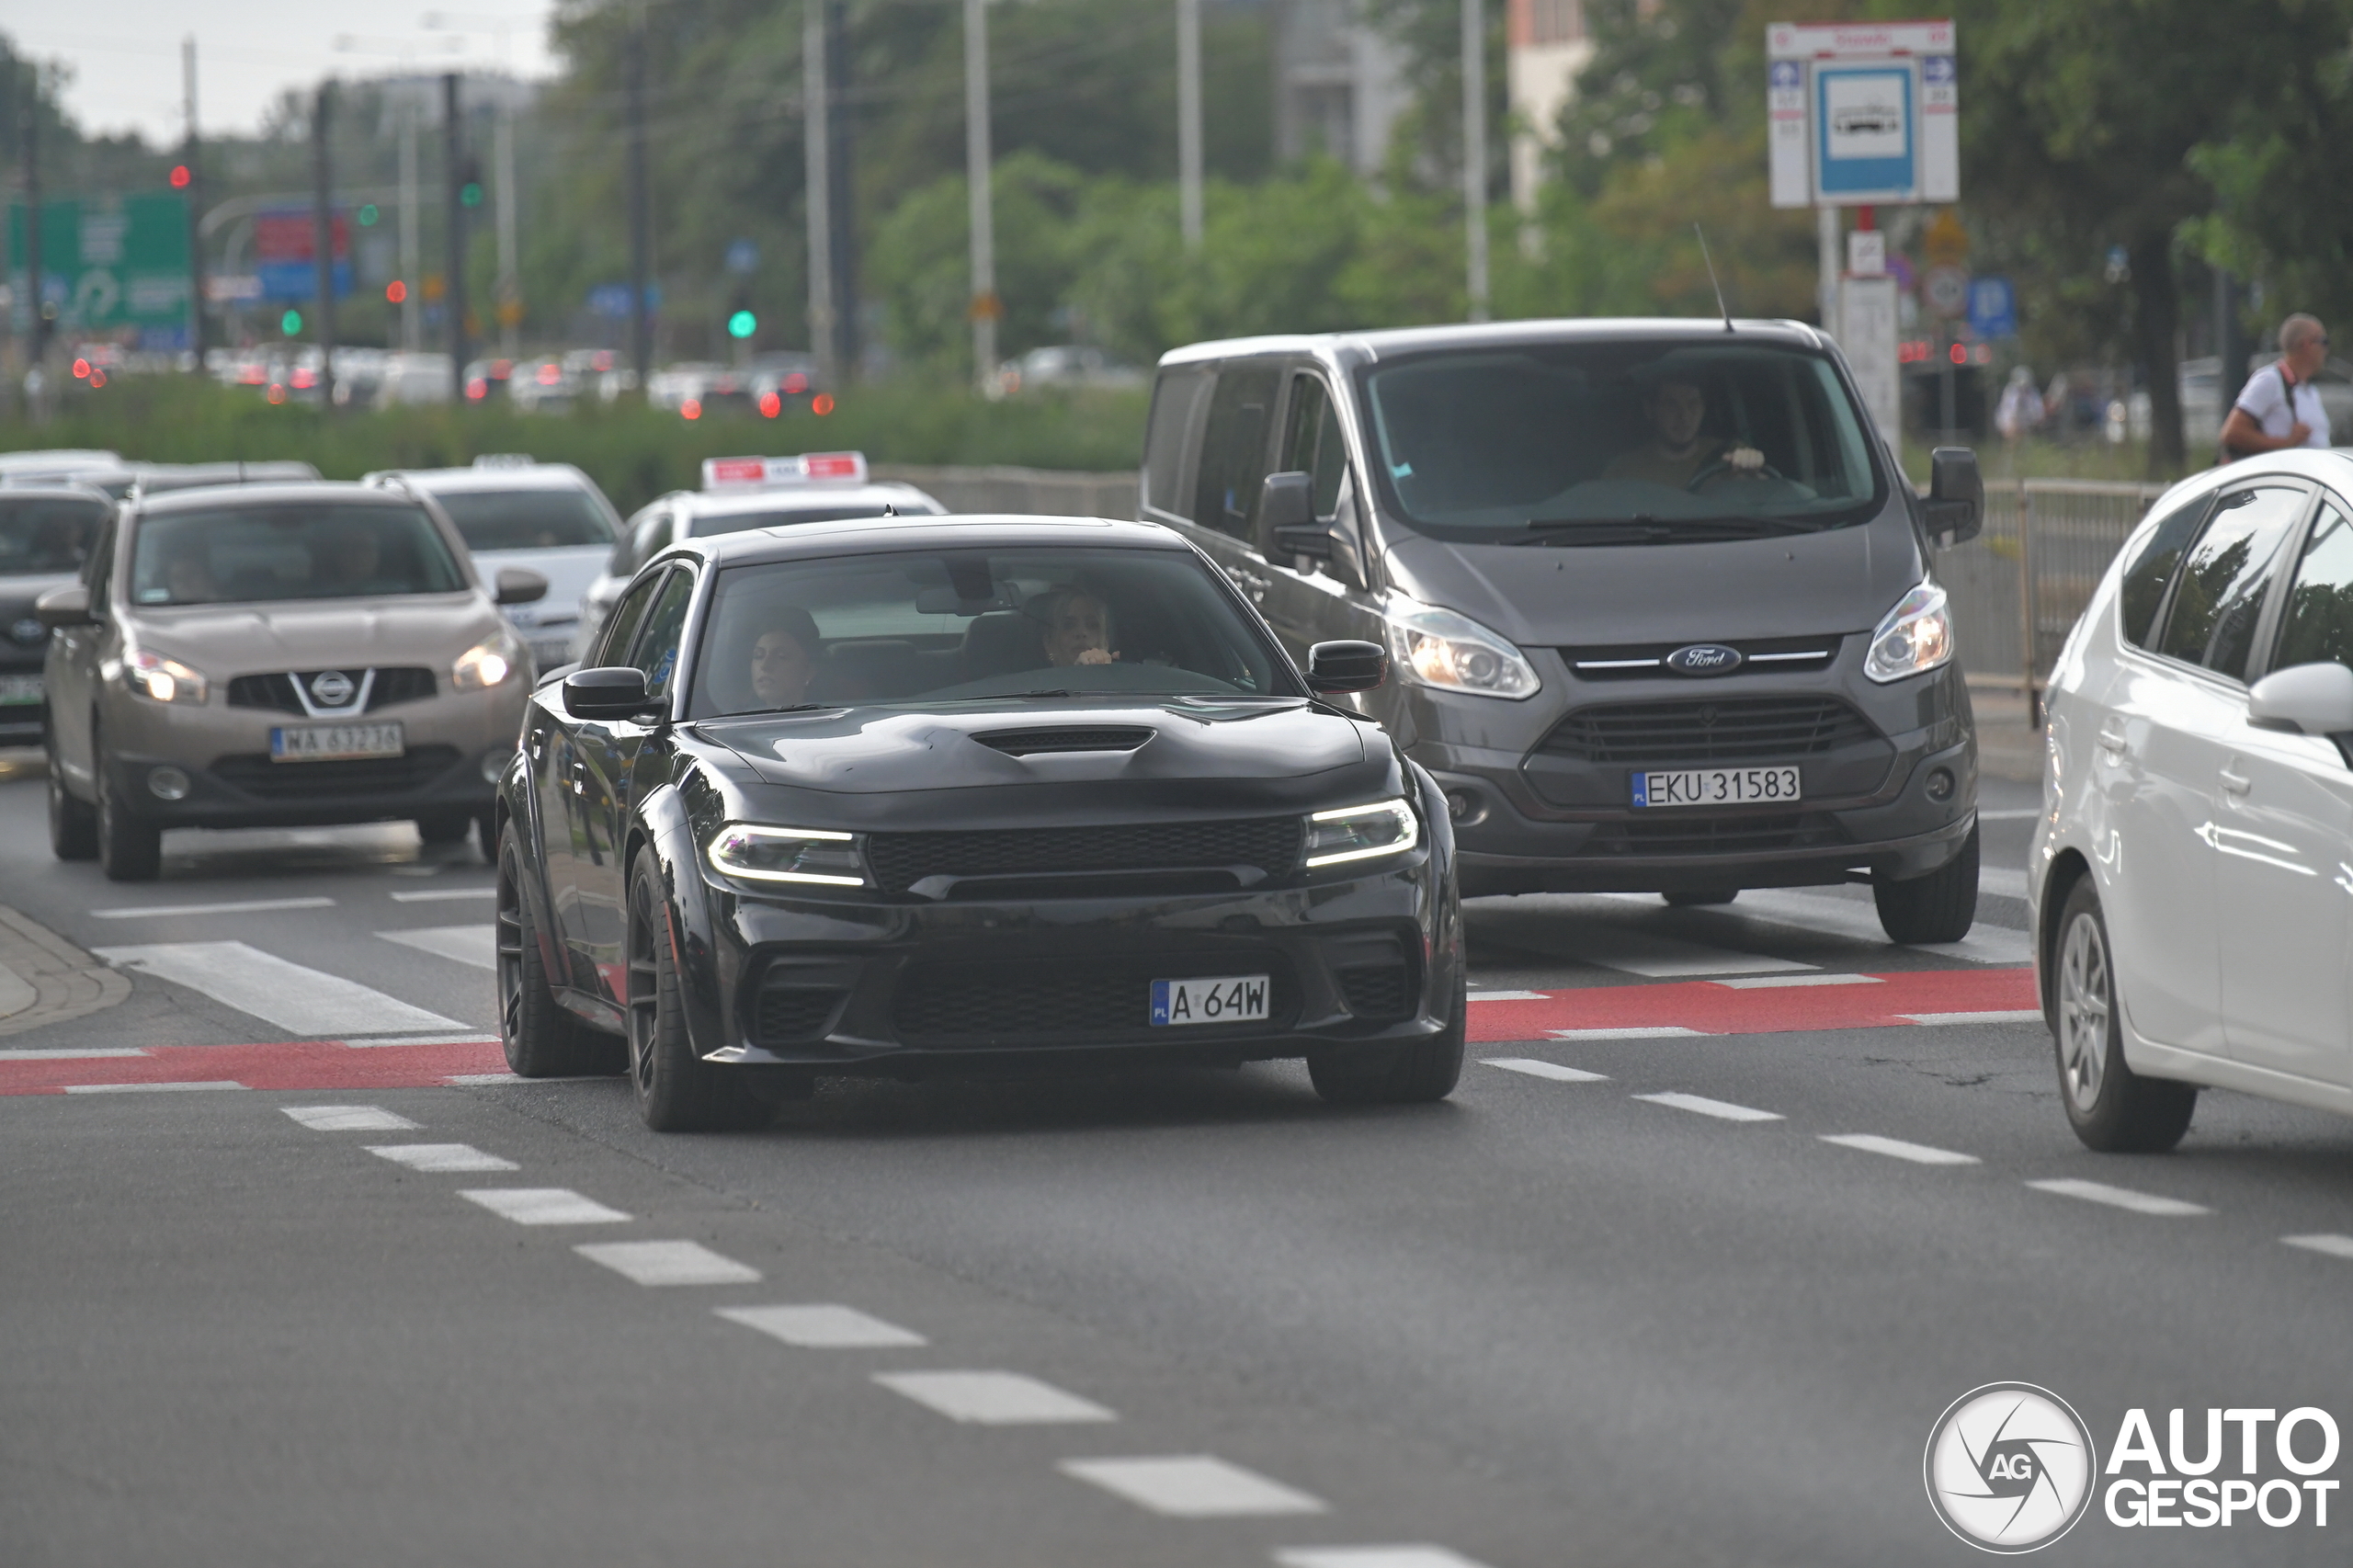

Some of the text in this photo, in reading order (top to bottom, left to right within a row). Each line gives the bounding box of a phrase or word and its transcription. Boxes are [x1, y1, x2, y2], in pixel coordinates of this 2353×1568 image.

[1686, 649, 1725, 666] Ford
[1648, 769, 1797, 803] EKU 31583
[1634, 793, 1645, 802] PL
[1172, 981, 1264, 1019] A 64W
[1154, 1007, 1167, 1017] PL
